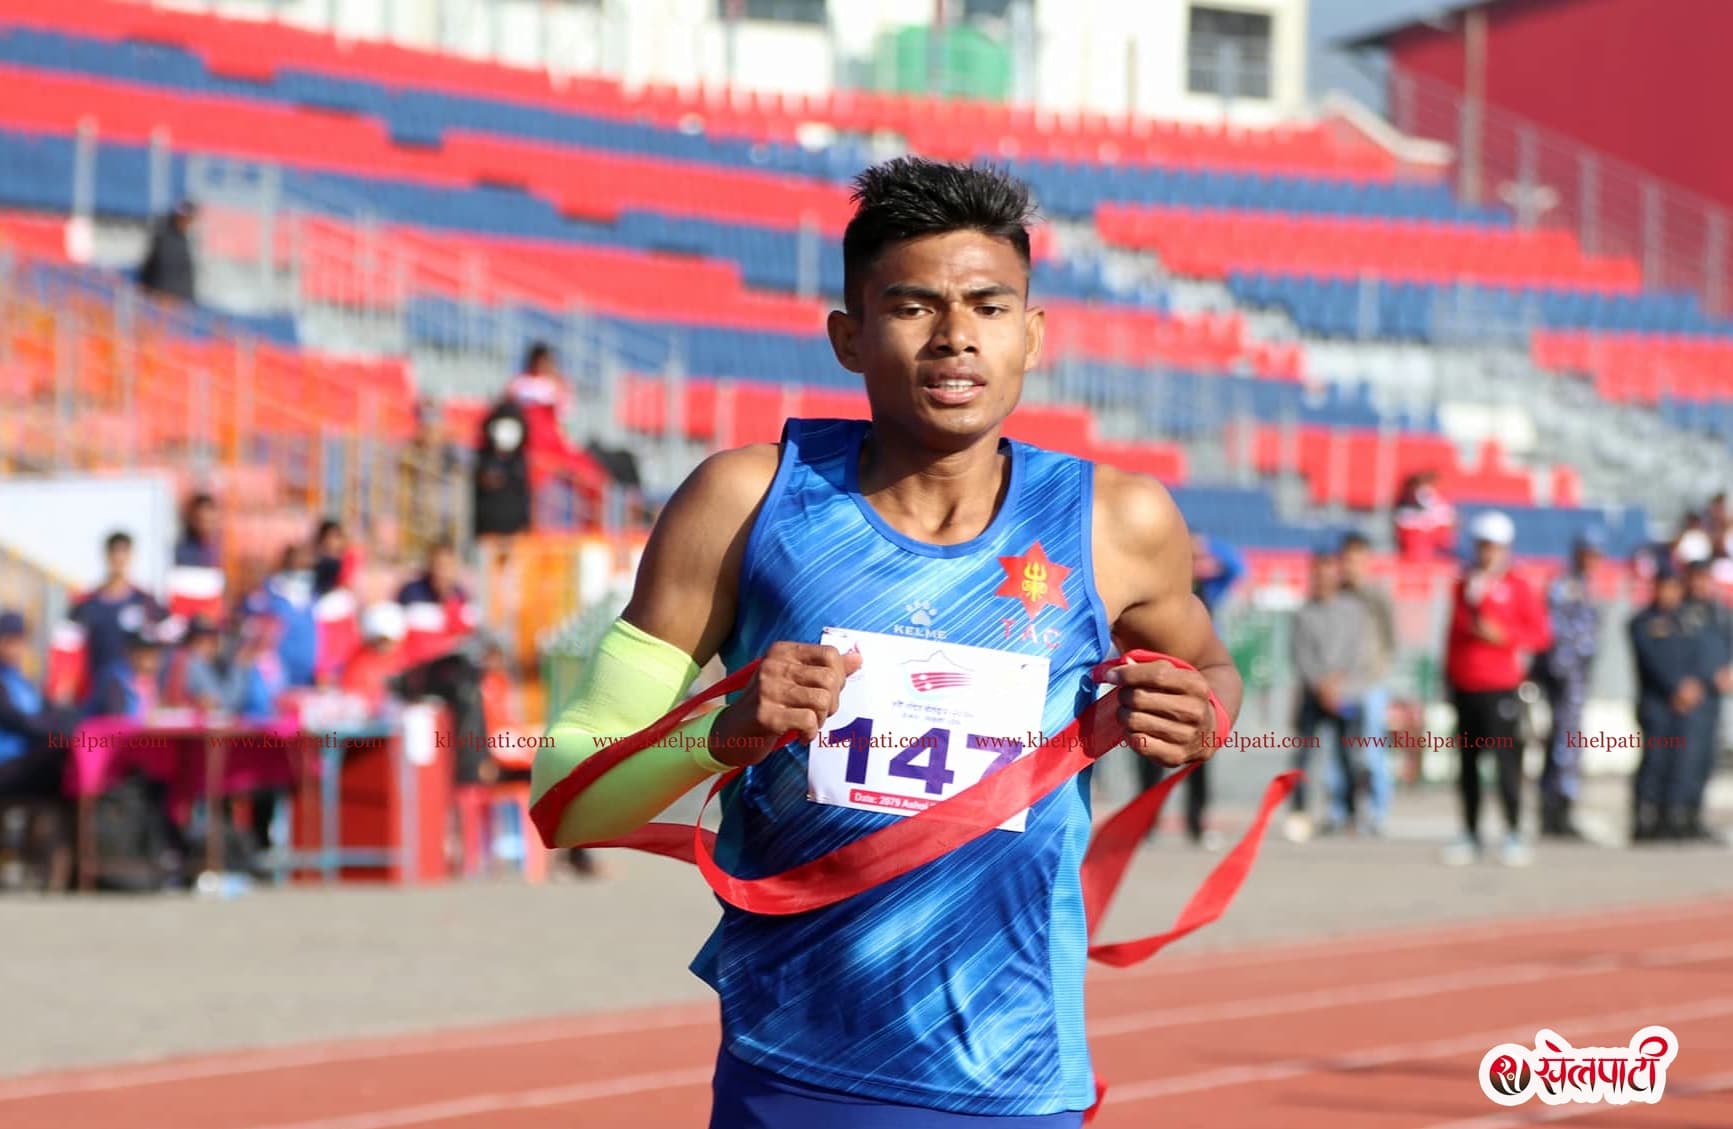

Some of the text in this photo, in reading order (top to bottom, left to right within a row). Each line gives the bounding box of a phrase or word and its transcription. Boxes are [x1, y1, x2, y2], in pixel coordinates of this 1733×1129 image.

[893, 623, 948, 640] KELME
[1001, 617, 1061, 650] TAC
[828, 716, 1023, 796] 147
[854, 792, 878, 805] Date:
